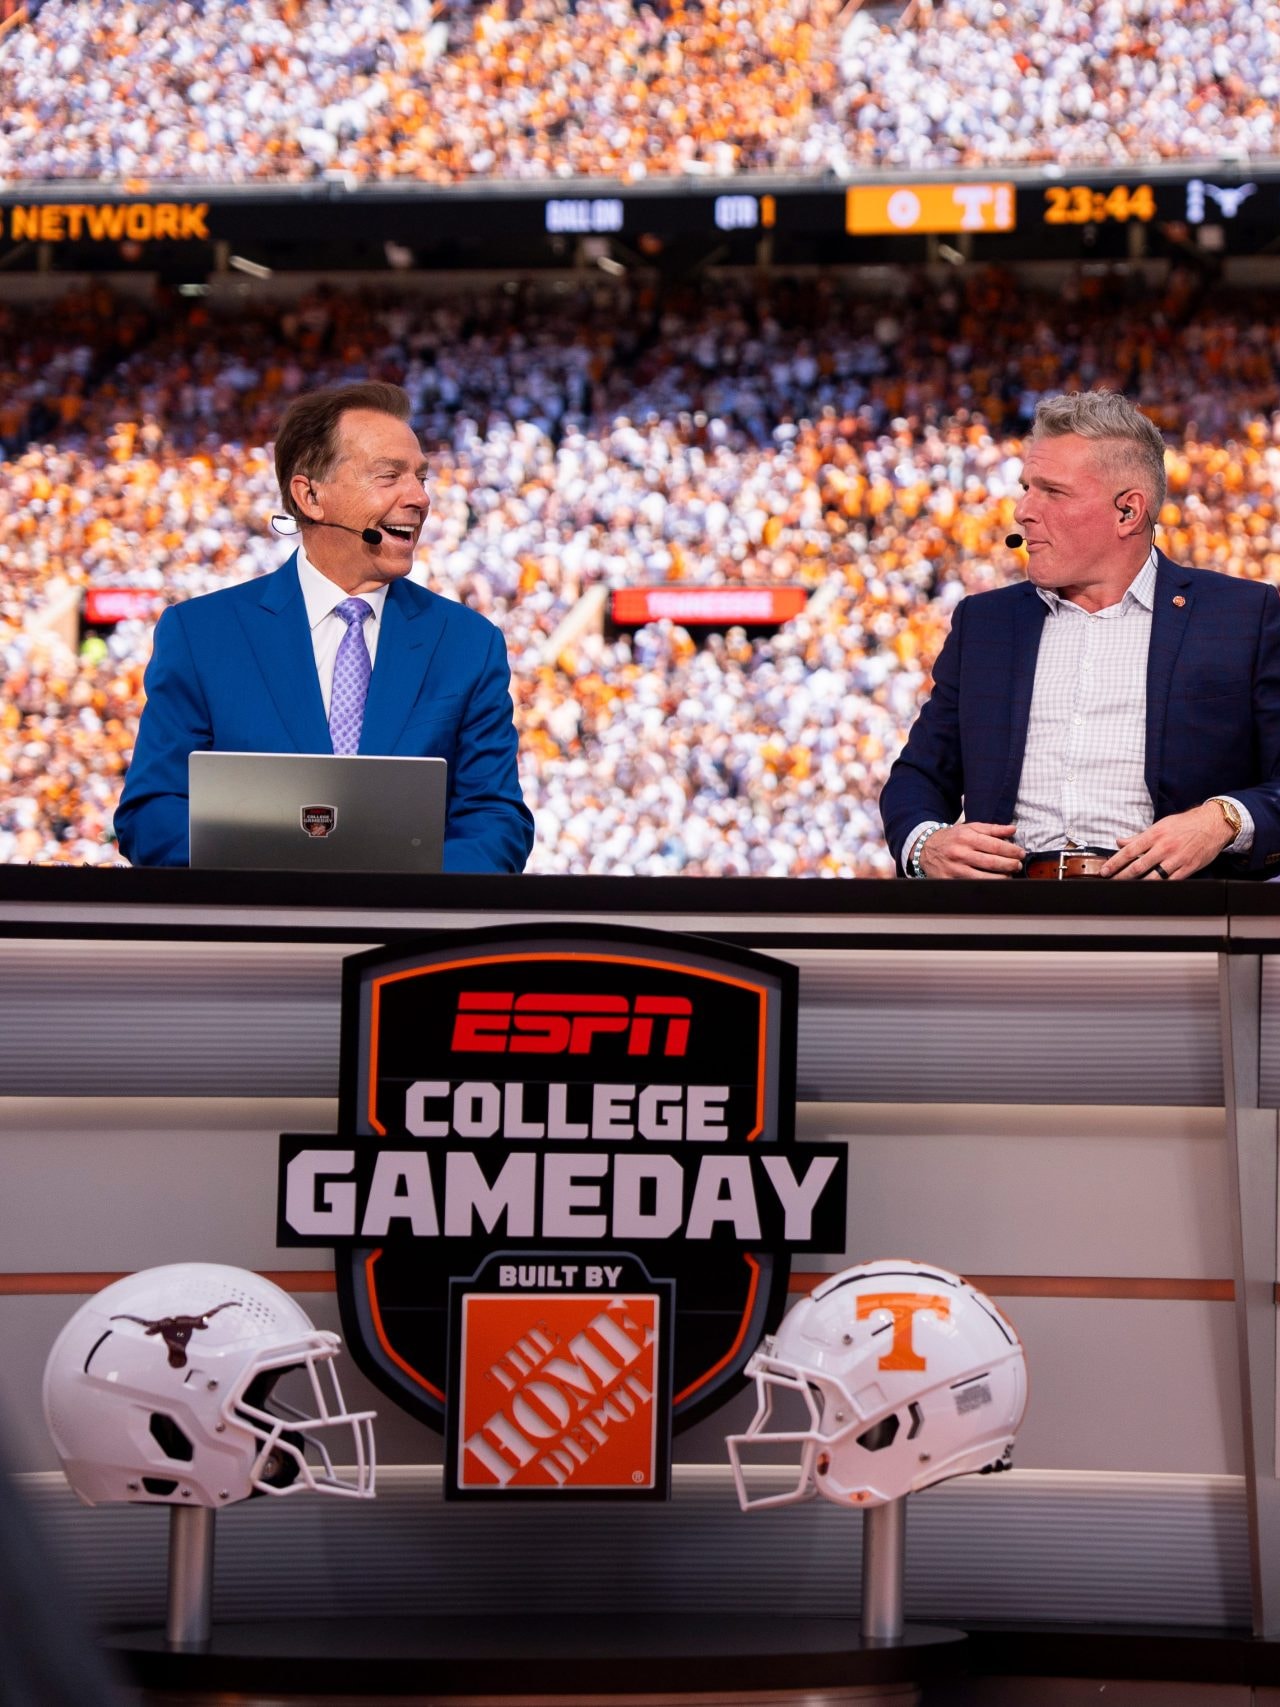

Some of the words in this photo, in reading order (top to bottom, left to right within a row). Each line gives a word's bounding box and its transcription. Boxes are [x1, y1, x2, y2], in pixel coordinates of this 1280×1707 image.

[11, 203, 210, 240] NETWORK
[1044, 184, 1156, 223] 23:44
[451, 991, 692, 1056] ESPN
[405, 1081, 729, 1141] COLLEGE
[285, 1149, 839, 1241] GAMEDAY
[499, 1265, 578, 1287] BUILT
[585, 1265, 623, 1288] BY
[483, 1318, 563, 1393] THE
[855, 1292, 950, 1371] T
[464, 1298, 657, 1489] HOME
[538, 1368, 653, 1488] DEPOT
